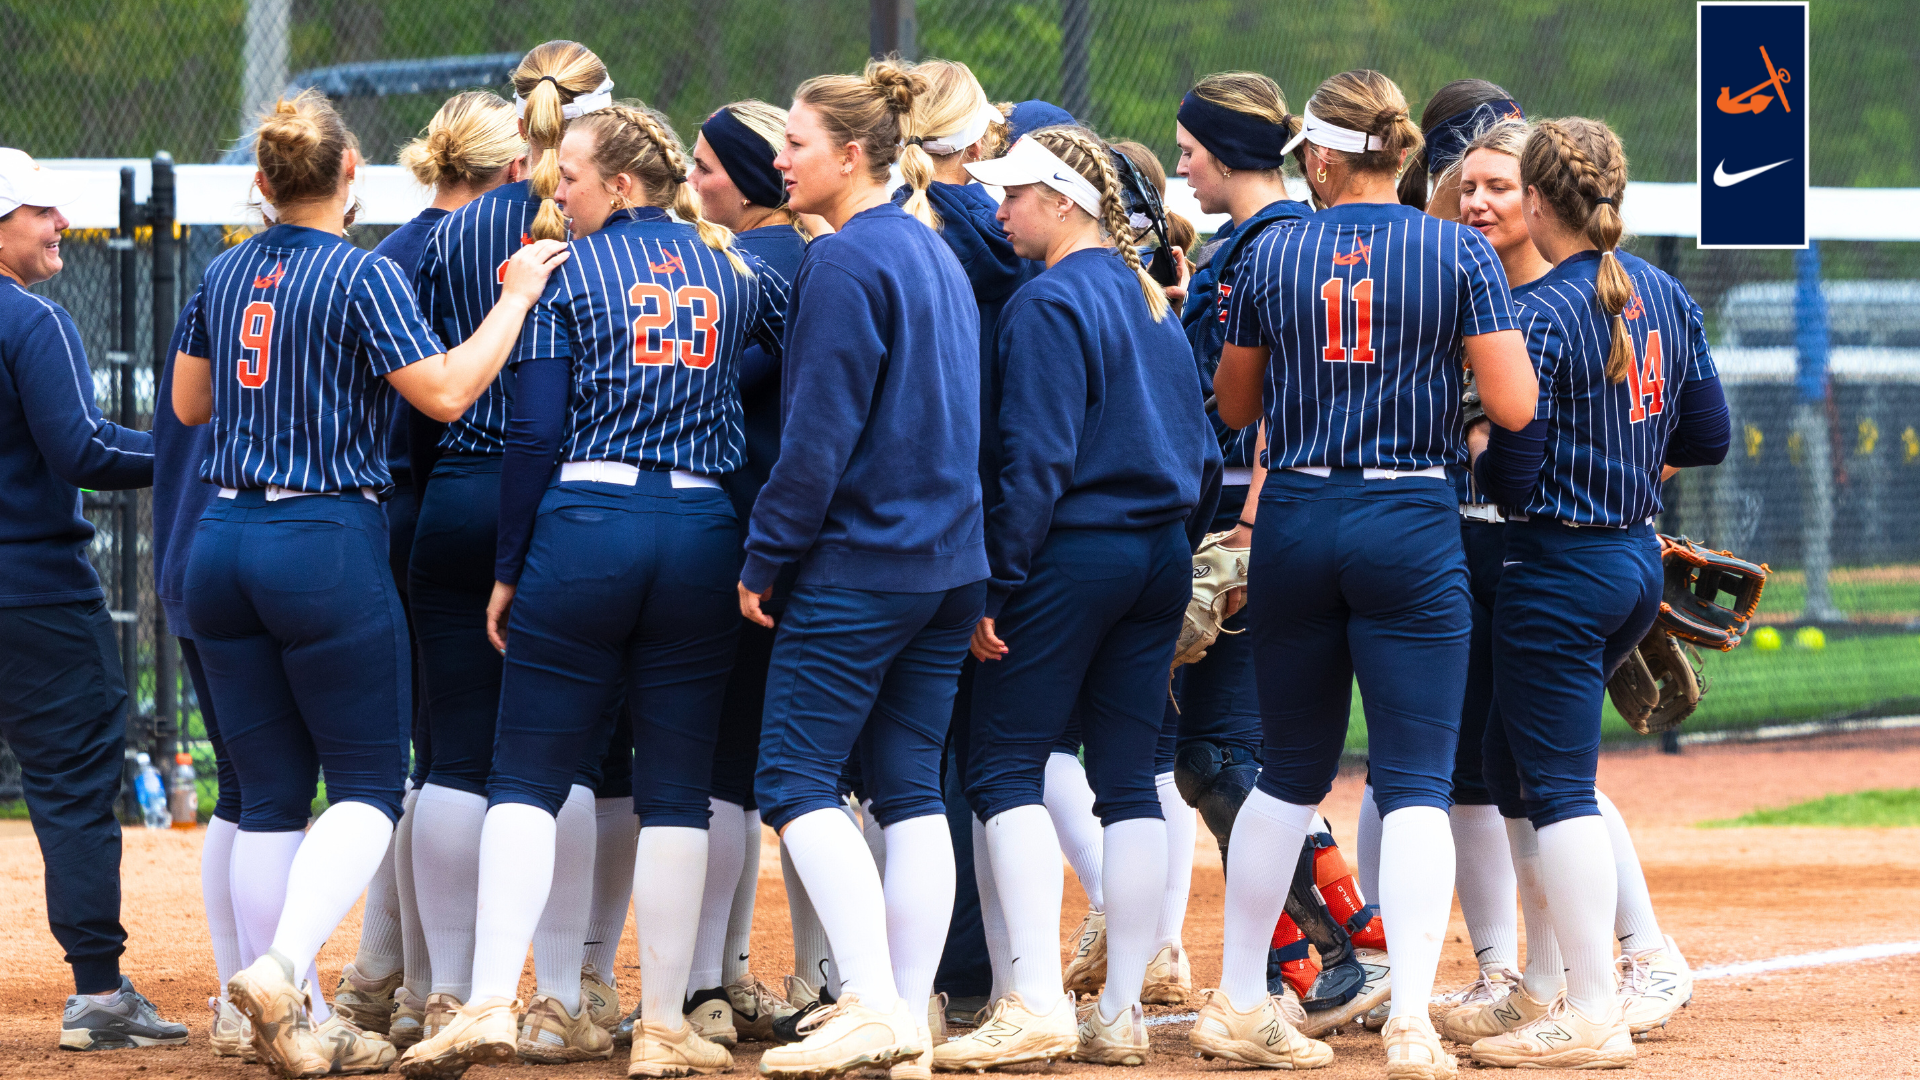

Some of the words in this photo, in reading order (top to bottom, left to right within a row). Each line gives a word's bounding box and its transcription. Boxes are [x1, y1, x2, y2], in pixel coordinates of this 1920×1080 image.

[236, 301, 276, 389] 9
[628, 282, 720, 371] 23
[1320, 277, 1376, 364] 11
[1626, 329, 1666, 424] 14
